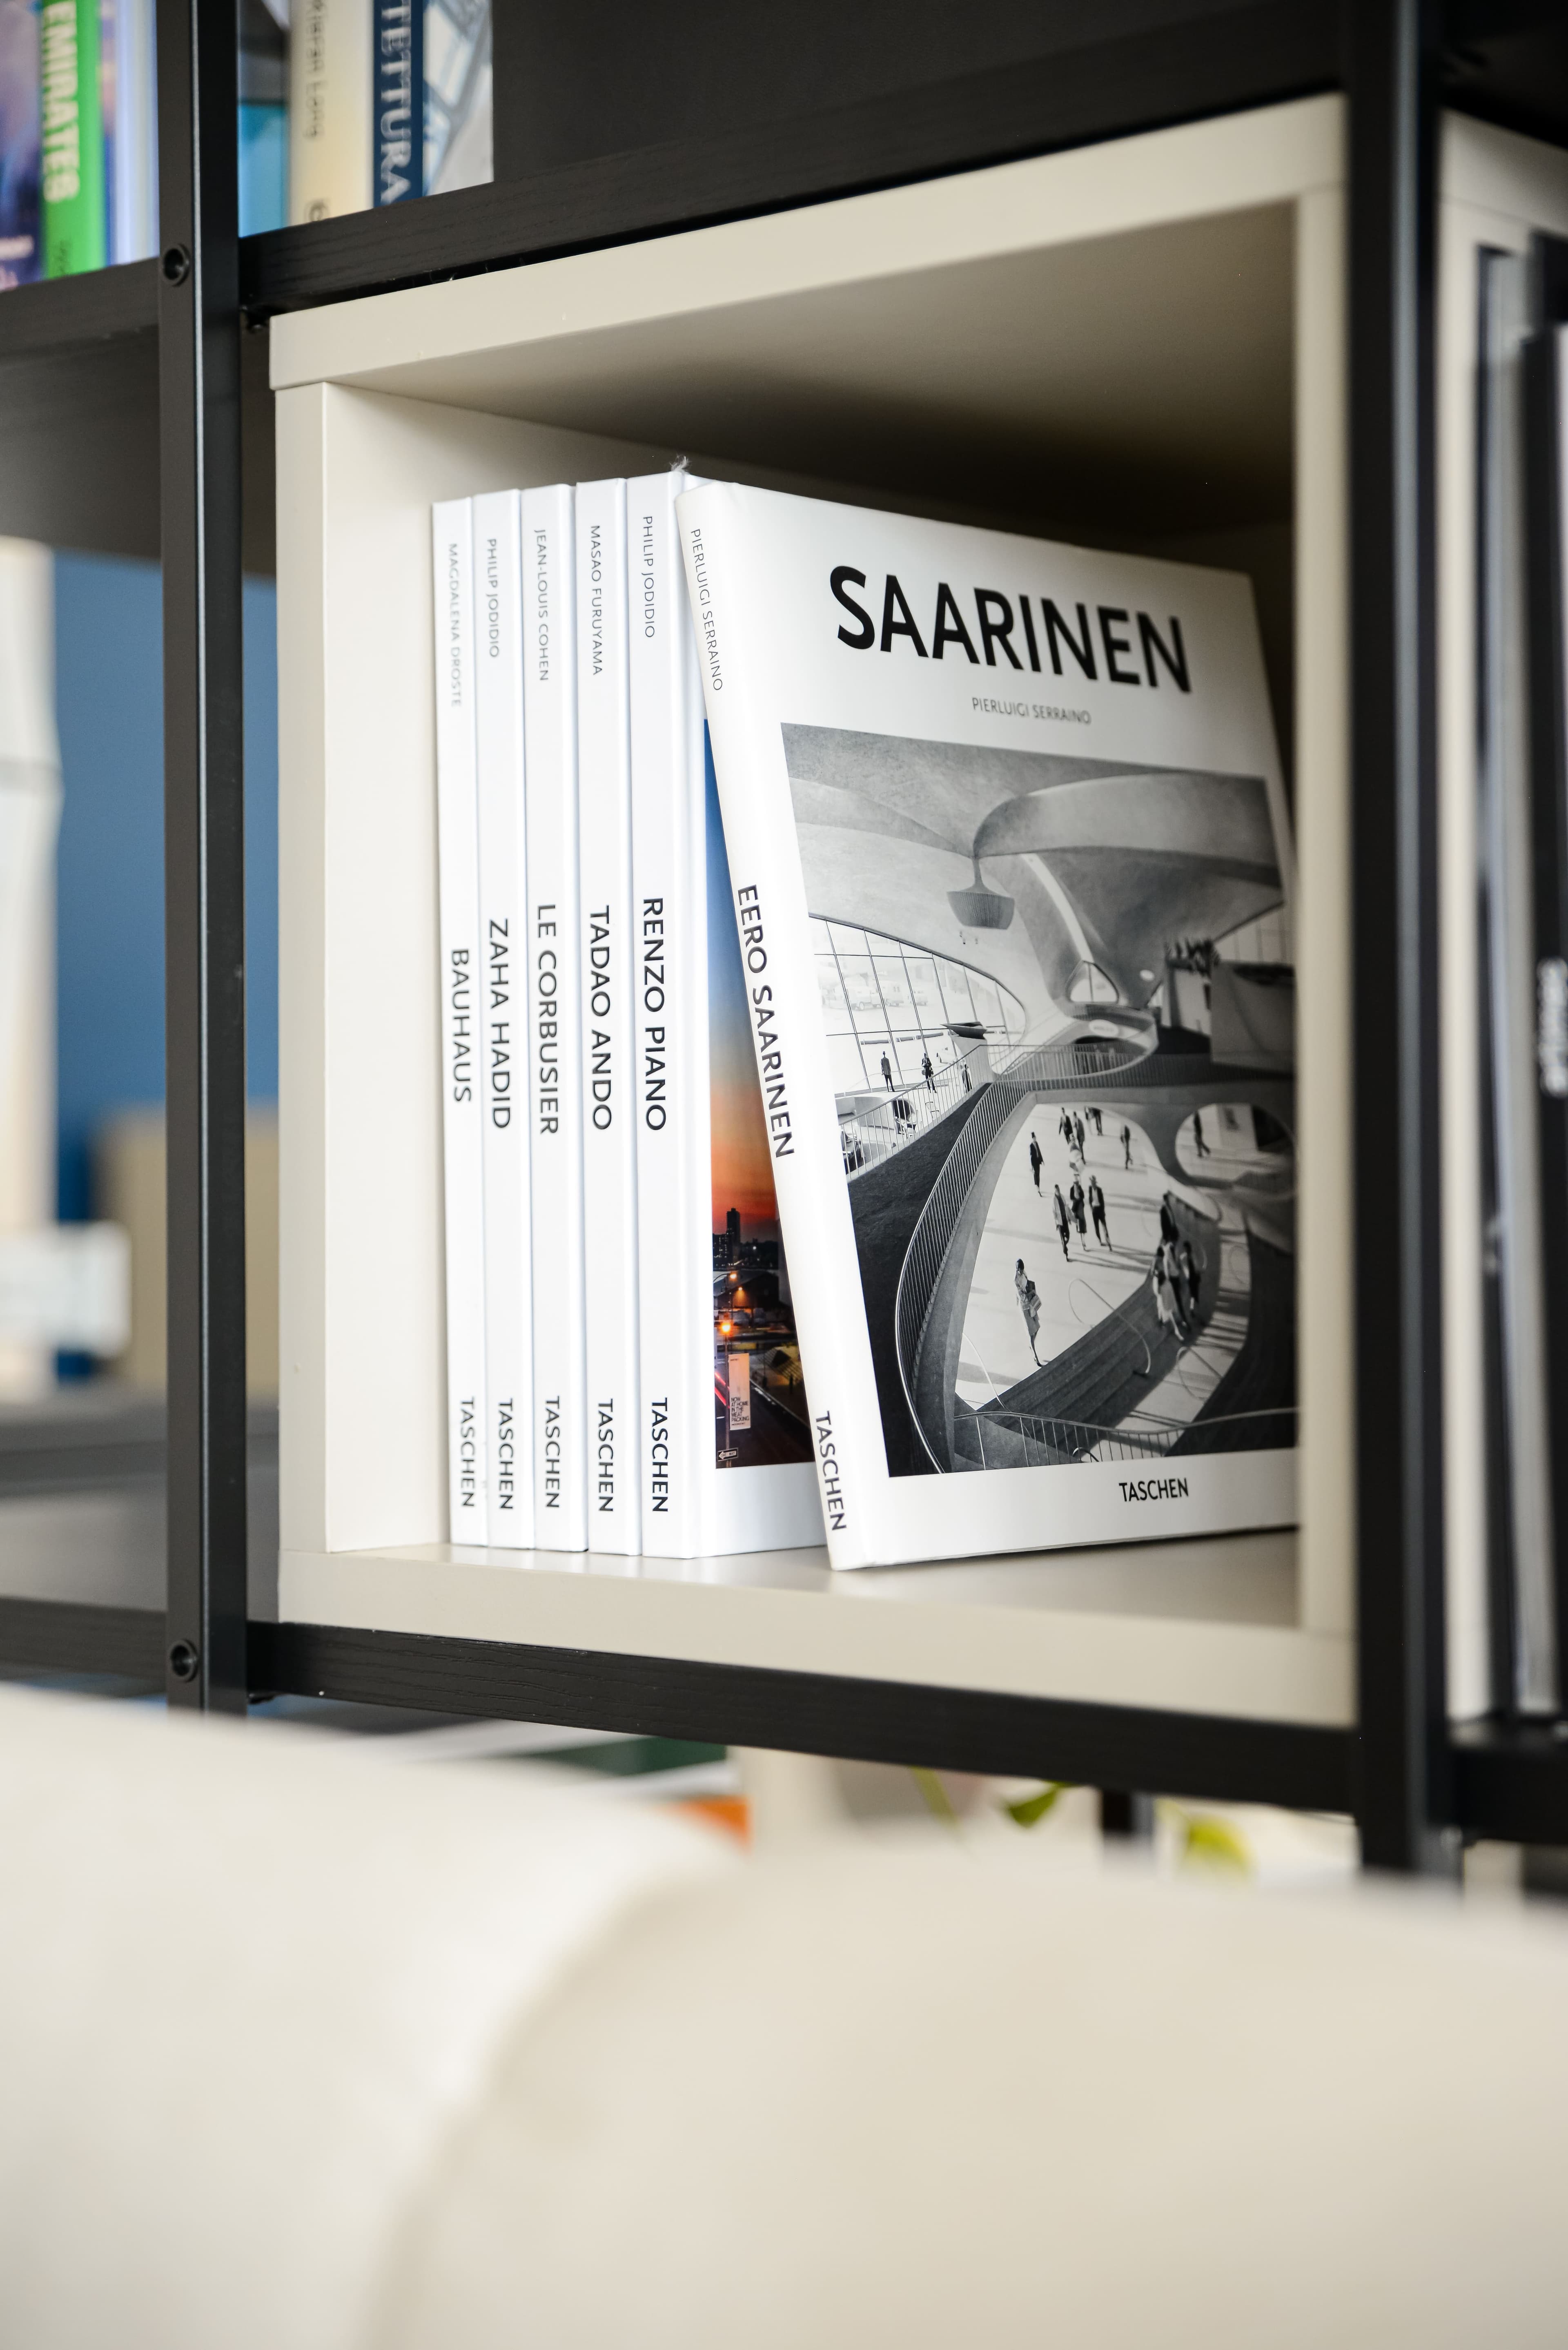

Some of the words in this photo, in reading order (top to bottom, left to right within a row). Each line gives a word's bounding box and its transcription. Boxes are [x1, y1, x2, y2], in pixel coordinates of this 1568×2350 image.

[42, 1, 80, 203] EMIRATES
[448, 543, 461, 641] MAGDALENA
[487, 539, 498, 588] PHILIP
[534, 529, 548, 618] JEAN-LOUIS
[591, 525, 601, 582] MASAO
[643, 516, 653, 566] PHILIP
[486, 594, 500, 658] JODIDIO
[539, 624, 549, 680] COHEN
[592, 588, 602, 675] FURUYAMA
[641, 572, 655, 638] JODIDIO
[690, 528, 710, 606] PIERLUIGI
[702, 611, 723, 691] SERRAINO
[829, 565, 1192, 693] SAARINEN
[451, 647, 461, 707] DROSTE
[972, 697, 1029, 718] PIERLUIGI
[1032, 705, 1091, 725] SERRAINO
[489, 918, 509, 1010] ZAHA
[537, 904, 556, 938] LE
[590, 905, 610, 1017] TADAO
[643, 898, 664, 1012] RENZO
[451, 948, 472, 1102] BAUHAUS
[538, 950, 559, 1134] CORBUSIER
[737, 885, 767, 974] EERO
[753, 985, 795, 1157] SAARINEN
[491, 1022, 511, 1129] HADID
[591, 1029, 612, 1130] ANDO
[645, 1026, 666, 1130] PIANO
[460, 1396, 475, 1507] TASCHEN
[498, 1398, 514, 1509] TASCHEN
[545, 1395, 560, 1508] TASCHEN
[598, 1398, 613, 1512] TASCHEN
[651, 1397, 668, 1512] TASCHEN
[815, 1410, 846, 1530] TASCHEN
[1118, 1477, 1189, 1502] TASCHEN
